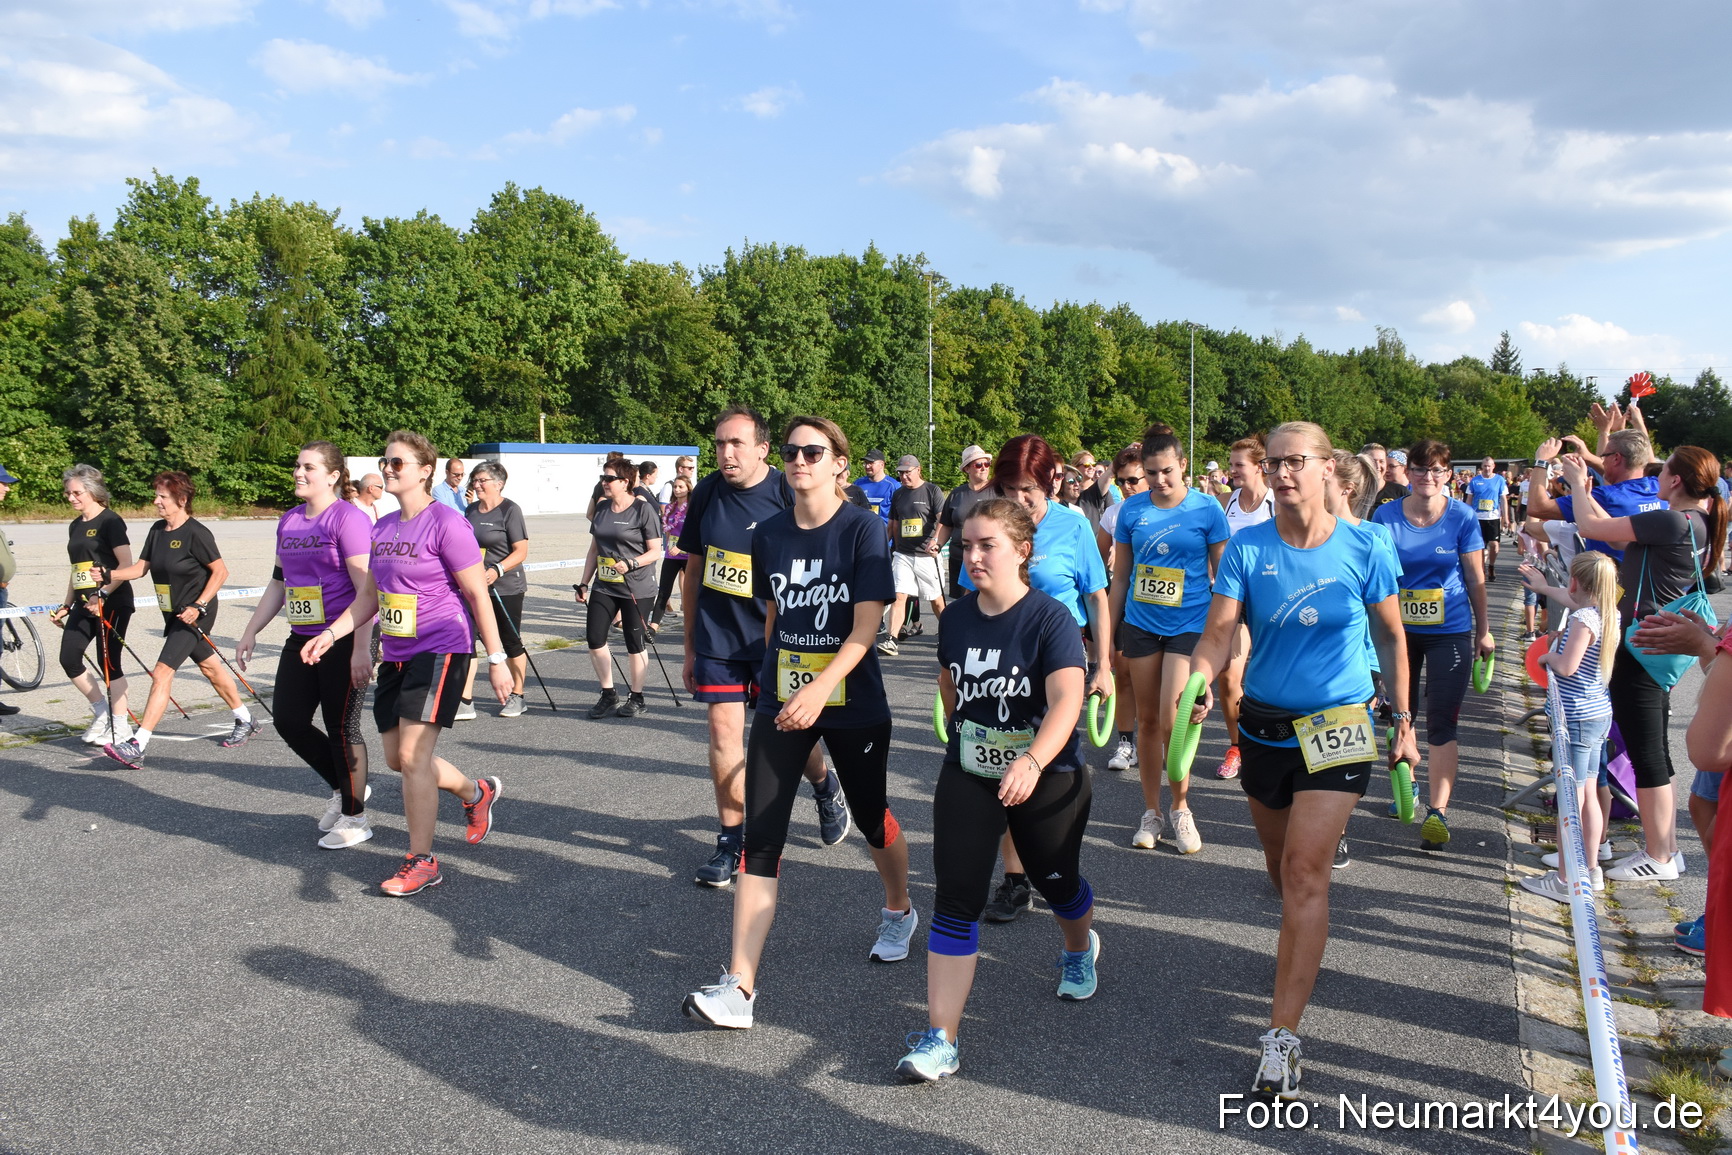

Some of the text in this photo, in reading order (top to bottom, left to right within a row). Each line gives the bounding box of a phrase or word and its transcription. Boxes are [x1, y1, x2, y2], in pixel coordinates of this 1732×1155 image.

[1638, 502, 1661, 512] TEAM
[281, 535, 324, 550] GRADL
[374, 542, 418, 558] GRADL
[76, 572, 87, 582] 56
[601, 566, 617, 576] 175
[710, 563, 748, 585] 1426
[1140, 578, 1176, 595] 1528
[289, 600, 312, 615] 938
[769, 572, 850, 631] Burgis
[1269, 576, 1337, 623] Team Schick Bau
[380, 607, 403, 625] 940
[1403, 602, 1438, 615] 1085
[789, 671, 814, 690] 39
[950, 662, 1031, 723] Burgis
[1311, 725, 1367, 753] 1524
[975, 745, 1017, 766] 389
